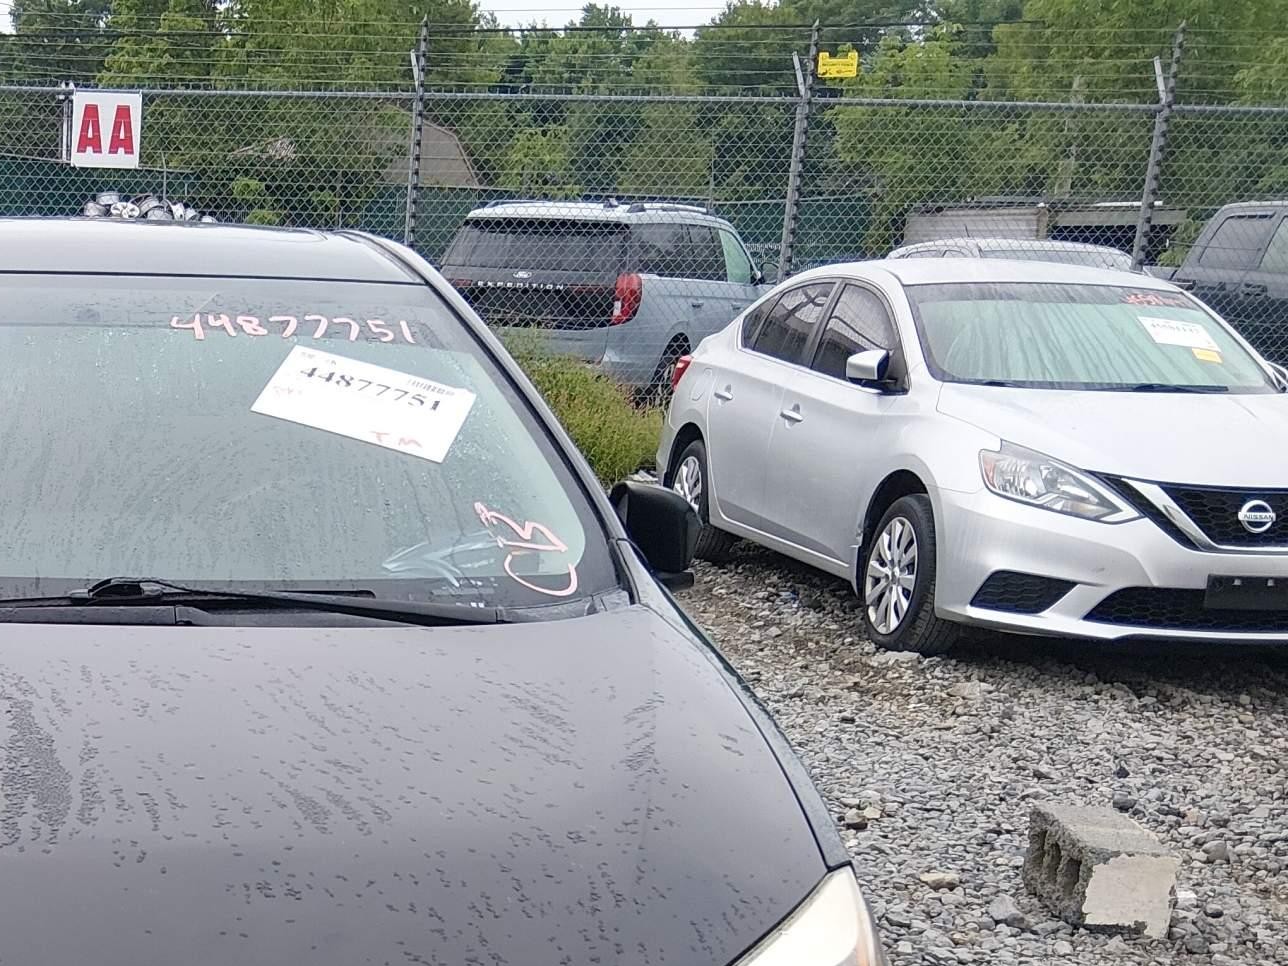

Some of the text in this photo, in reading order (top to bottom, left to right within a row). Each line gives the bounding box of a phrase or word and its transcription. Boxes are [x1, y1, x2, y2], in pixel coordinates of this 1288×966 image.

[76, 103, 135, 155] AA
[170, 313, 416, 343] 44877751
[300, 367, 442, 411] 44877751
